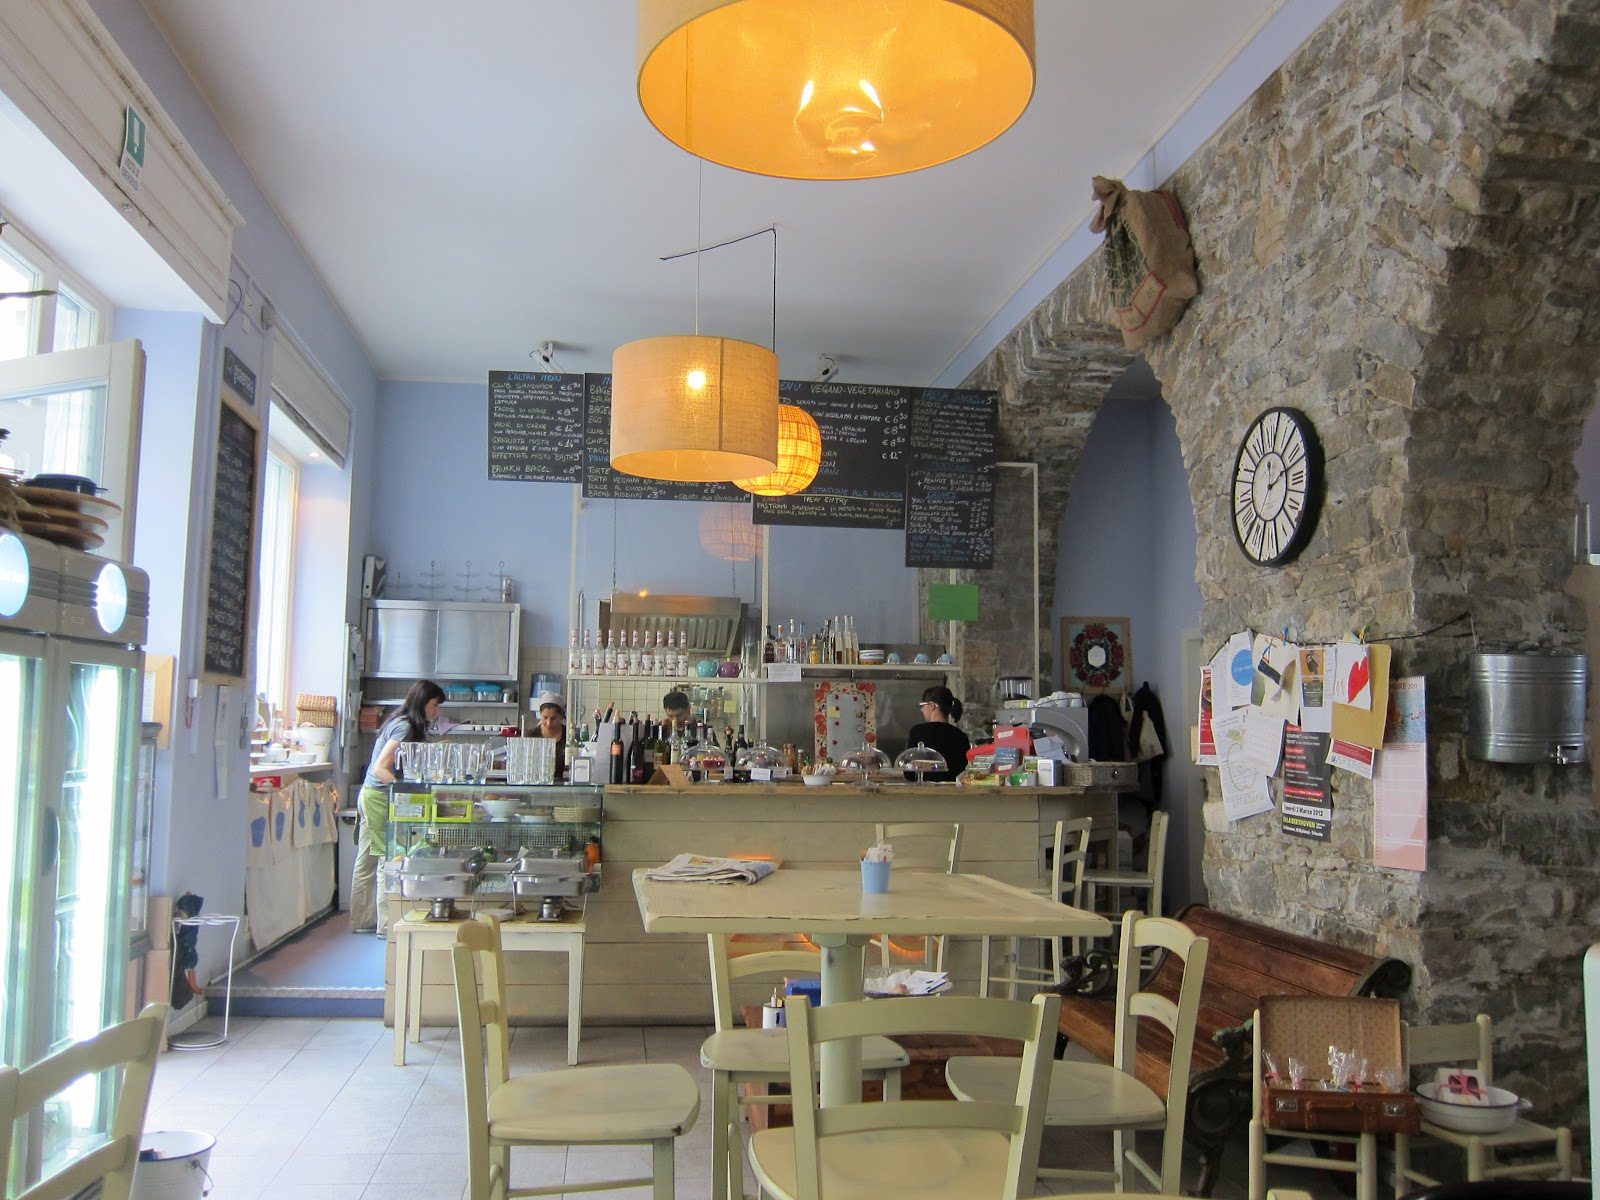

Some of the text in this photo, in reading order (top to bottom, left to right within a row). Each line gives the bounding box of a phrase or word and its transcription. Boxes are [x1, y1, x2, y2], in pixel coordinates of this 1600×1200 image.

[780, 381, 801, 391] ENU
[586, 437, 609, 445] CHIPS
[491, 464, 521, 473] BRUNCH
[524, 465, 550, 473] BAGEL
[824, 497, 849, 505] ENTRY
[1312, 809, 1324, 817] 2012
